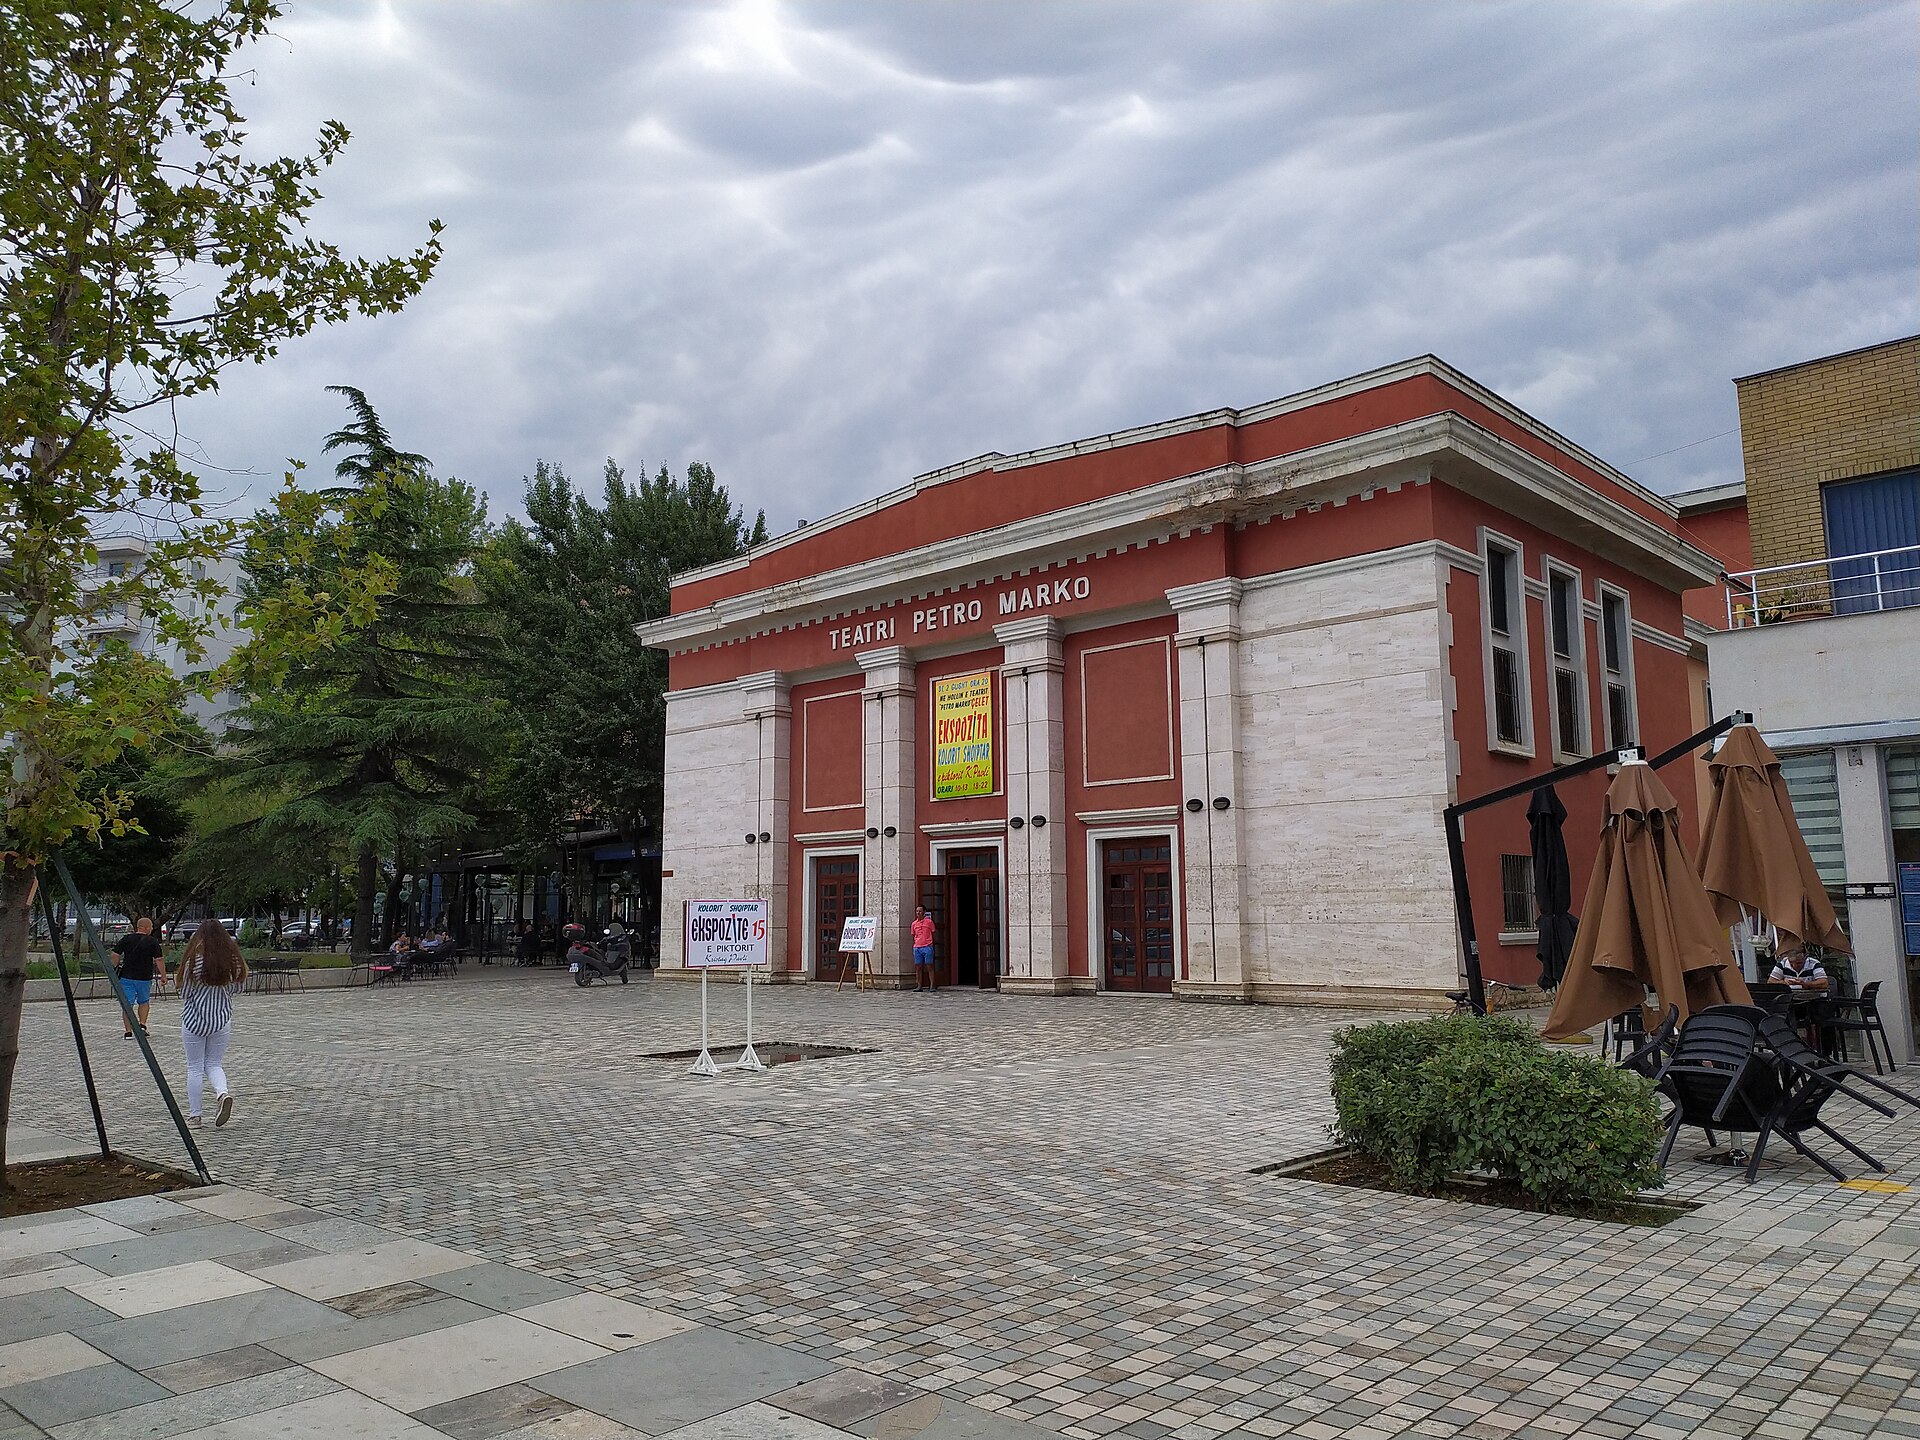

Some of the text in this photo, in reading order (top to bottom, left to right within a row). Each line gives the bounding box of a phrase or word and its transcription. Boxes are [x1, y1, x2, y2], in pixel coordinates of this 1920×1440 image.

[830, 576, 1091, 650] TEATRI PETRO MARKO
[938, 742, 990, 766] KOLORIT SHQIPTAR
[937, 786, 954, 794] ORARI
[730, 904, 759, 912] SHQIPTAR
[752, 920, 765, 940] 15
[716, 944, 754, 952] PIKTORIT
